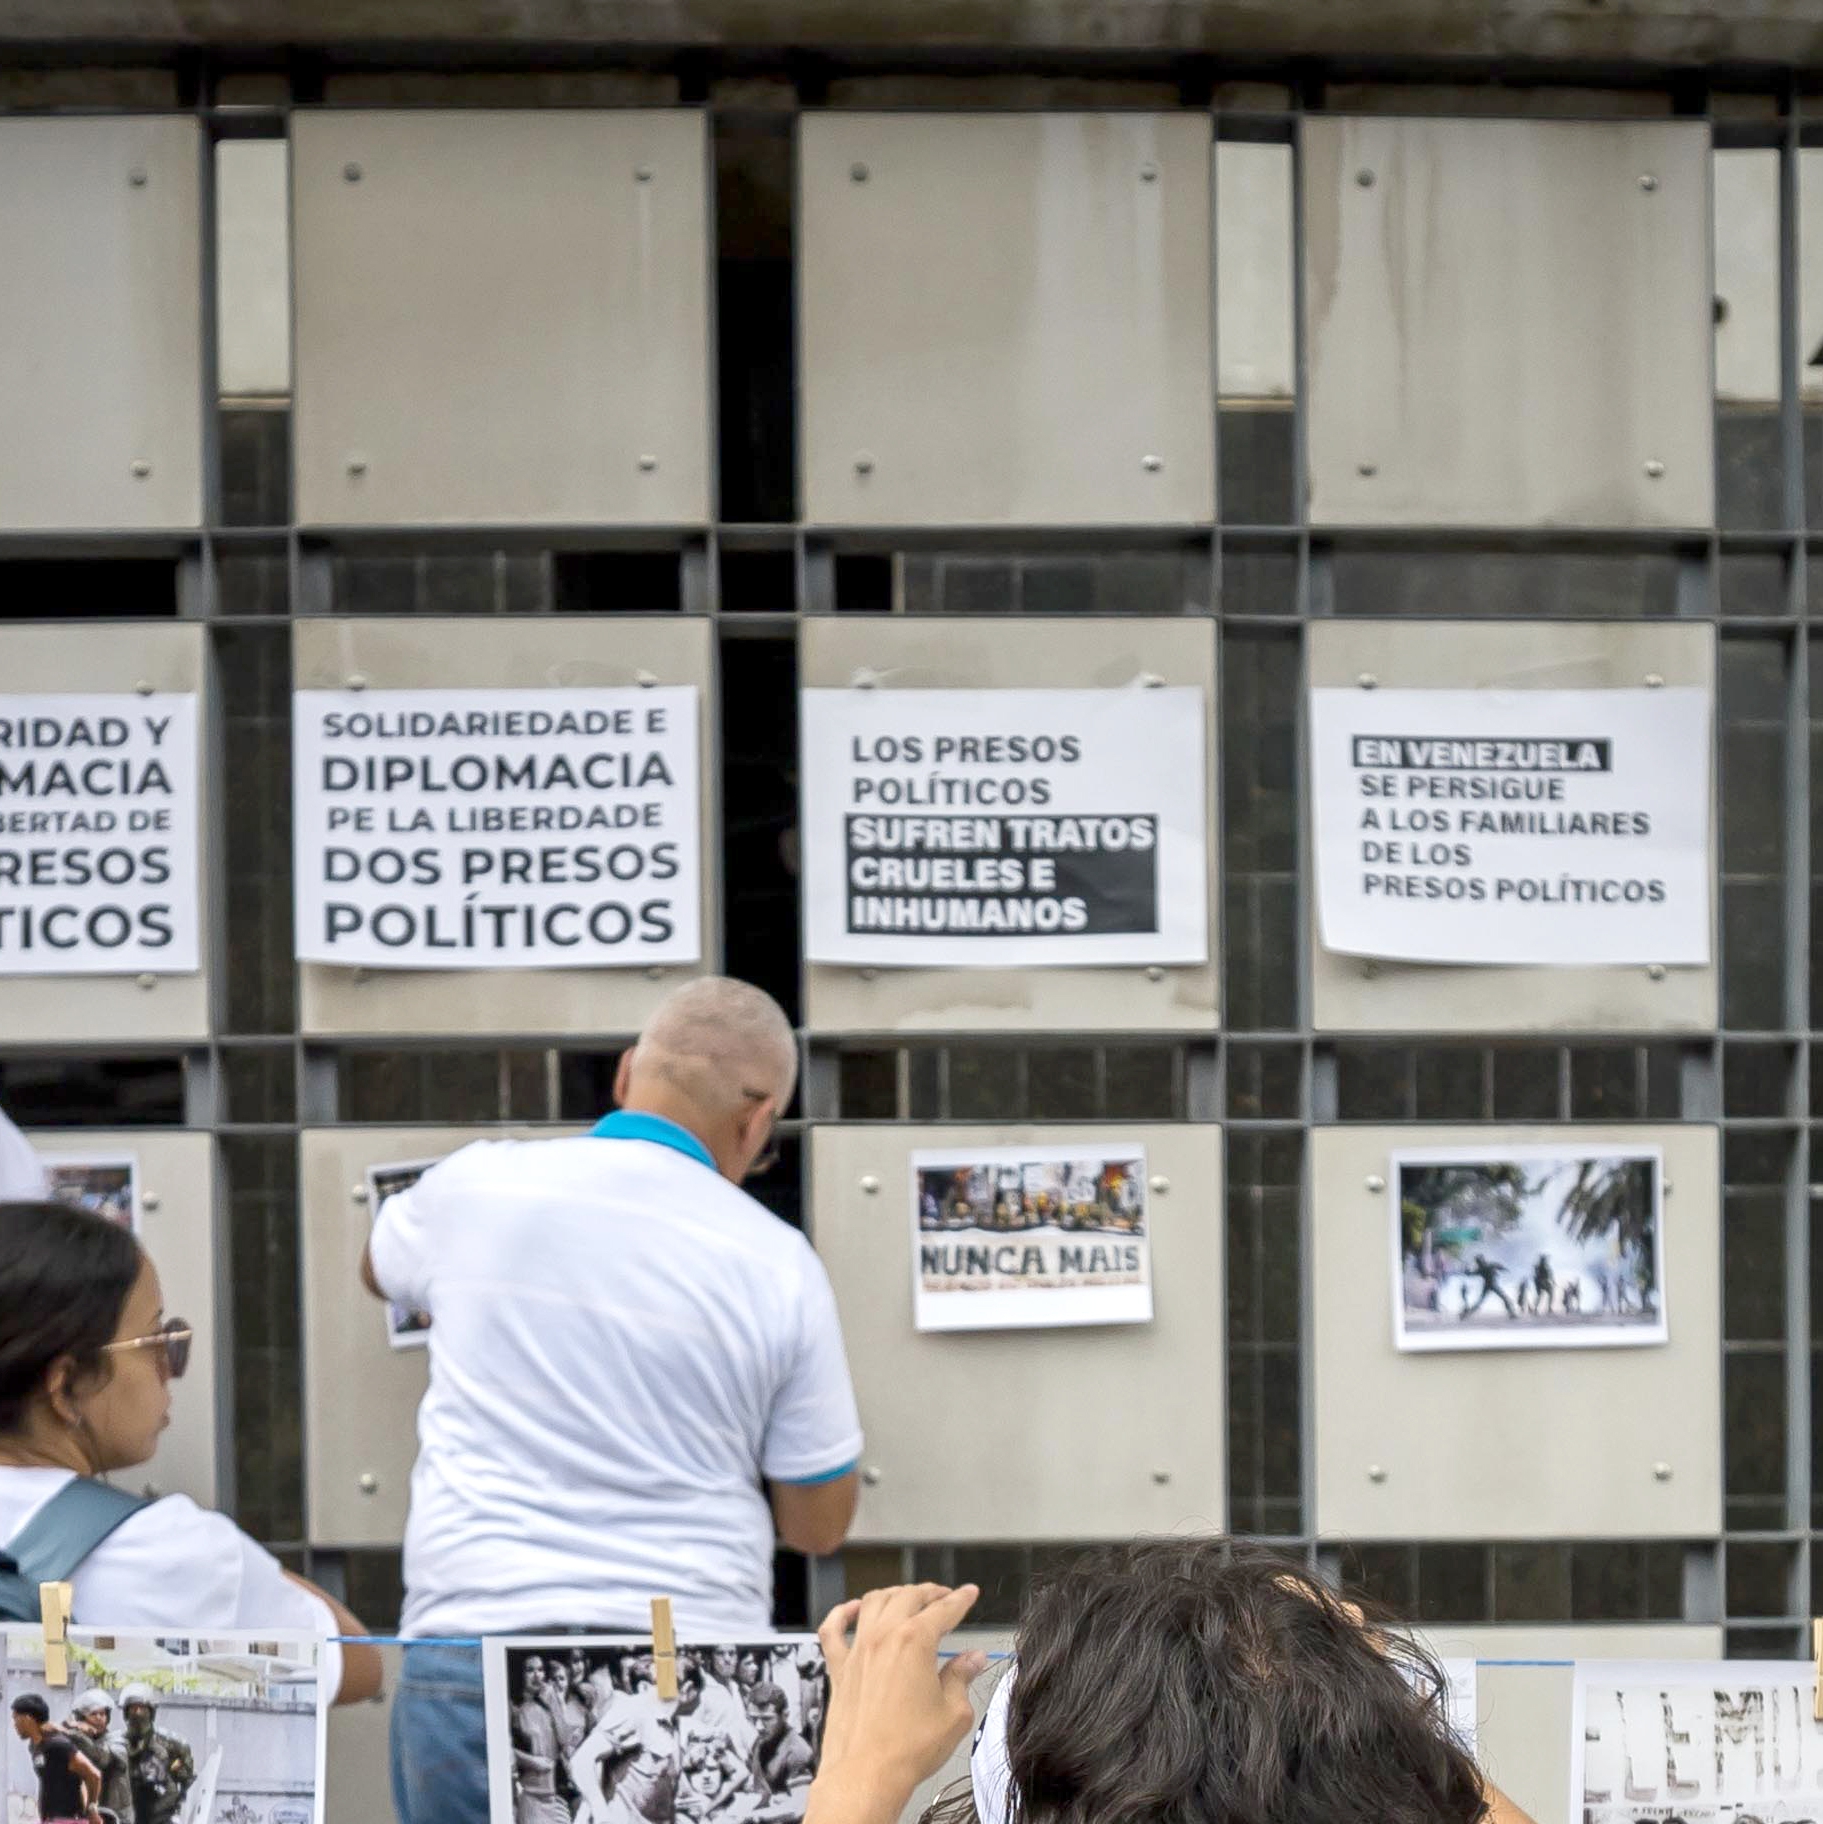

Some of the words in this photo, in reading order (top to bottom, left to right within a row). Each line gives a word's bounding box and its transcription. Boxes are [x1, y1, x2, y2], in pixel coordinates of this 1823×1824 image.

[141, 714, 171, 747] Y
[323, 709, 633, 738] SOLIDARIEDADE
[647, 708, 667, 734] E
[853, 736, 922, 763] LOS
[934, 735, 1080, 763] PRESOS
[1357, 740, 1401, 768] EN
[1407, 741, 1601, 769] VENEZUELA
[323, 752, 673, 792] DIPLOMACIA
[853, 772, 1050, 806] POLÍTICOS
[1361, 775, 1398, 799] SE
[1407, 774, 1564, 802] PERSIGUE
[128, 808, 172, 832] DE
[328, 807, 375, 832] PE
[388, 806, 434, 832] LA
[447, 802, 663, 831] LIBERDADE
[1361, 810, 1381, 832] A
[1389, 808, 1451, 834] LOS
[1459, 809, 1650, 836] FAMILIARES
[851, 819, 1000, 850] SUFREN
[1007, 818, 1155, 851] TRATOS
[324, 847, 441, 885] DOS
[462, 842, 679, 883] PRESOS
[1363, 841, 1404, 865] DE
[1413, 841, 1471, 867] LOS
[851, 857, 1025, 889] CRUELES
[1031, 858, 1055, 889] E
[1364, 873, 1487, 902] PRESOS
[1496, 871, 1666, 904] POLÍTICOS
[324, 892, 674, 949] POLÍTICOS
[851, 896, 1088, 931] INHUMANOS
[921, 1245, 1046, 1275] NUNCA
[1059, 1246, 1139, 1273] MAIS
